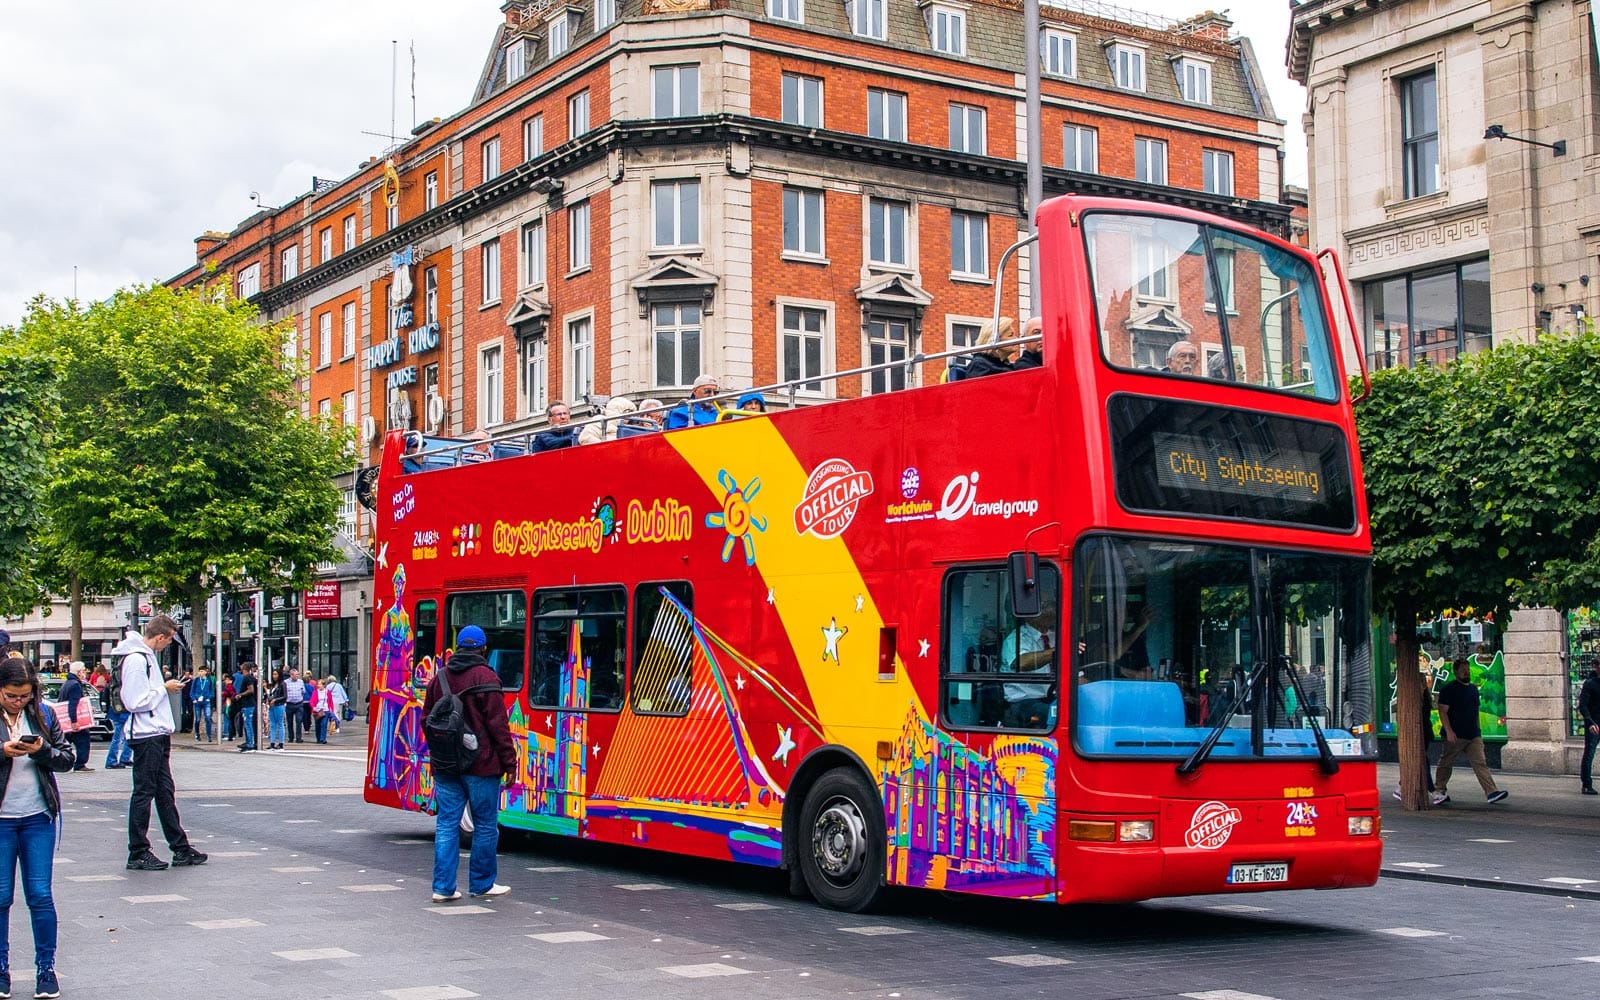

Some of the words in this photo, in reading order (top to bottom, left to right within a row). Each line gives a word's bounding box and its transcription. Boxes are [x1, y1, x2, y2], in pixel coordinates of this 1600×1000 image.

[395, 304, 413, 329] The
[367, 336, 401, 370] HAPPY
[408, 322, 440, 355] RING
[387, 364, 417, 389] HOUSE
[1169, 452, 1207, 482] City
[1217, 456, 1319, 494] Sightseeing
[392, 490, 404, 505] Hop
[404, 483, 413, 497] On
[801, 475, 869, 526] OFFICIAL
[394, 506, 406, 522] Hop
[405, 496, 415, 513] Off
[626, 497, 692, 544] Dublin
[823, 506, 853, 533] TOUR
[320, 584, 337, 592] Knight
[1286, 802, 1304, 825] 24
[1191, 811, 1238, 843] OFFICIAL
[1207, 829, 1228, 846] TOUR
[1234, 866, 1286, 882] 03-KE-16297
